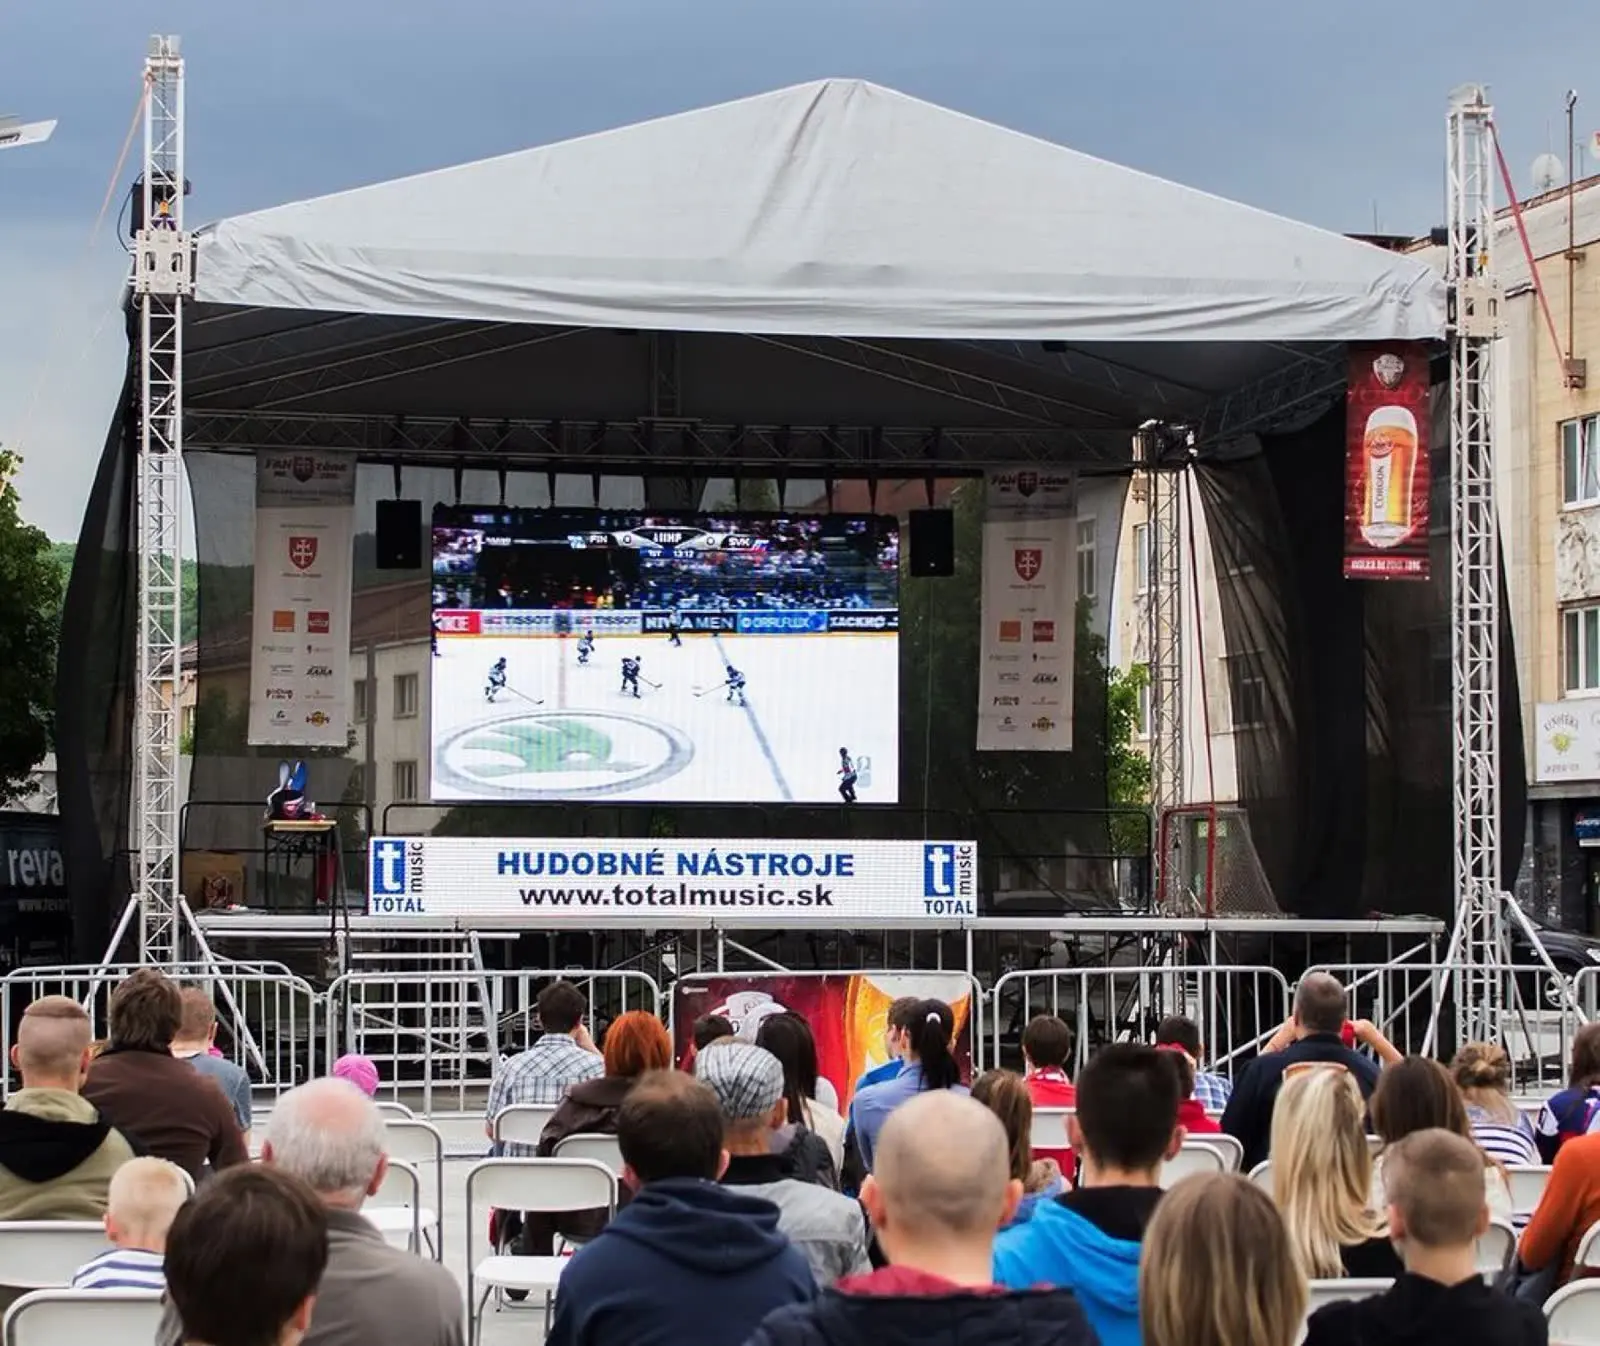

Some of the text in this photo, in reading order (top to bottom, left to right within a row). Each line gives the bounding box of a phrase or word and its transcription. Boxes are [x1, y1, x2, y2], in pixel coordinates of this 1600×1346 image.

[589, 535, 608, 544] FIN
[728, 537, 750, 546] SVK
[504, 615, 552, 625] TISSOT
[594, 615, 639, 625] TISSOT
[645, 616, 735, 629] NIVA MEN
[7, 849, 65, 887] reva
[408, 842, 424, 893] music
[498, 847, 855, 877] HUDOBNÉ NÁSTROJE
[956, 846, 972, 895] music
[519, 883, 834, 906] www.totalmusic.sk
[373, 897, 425, 913] TOTAL
[924, 900, 974, 915] TOTAL
